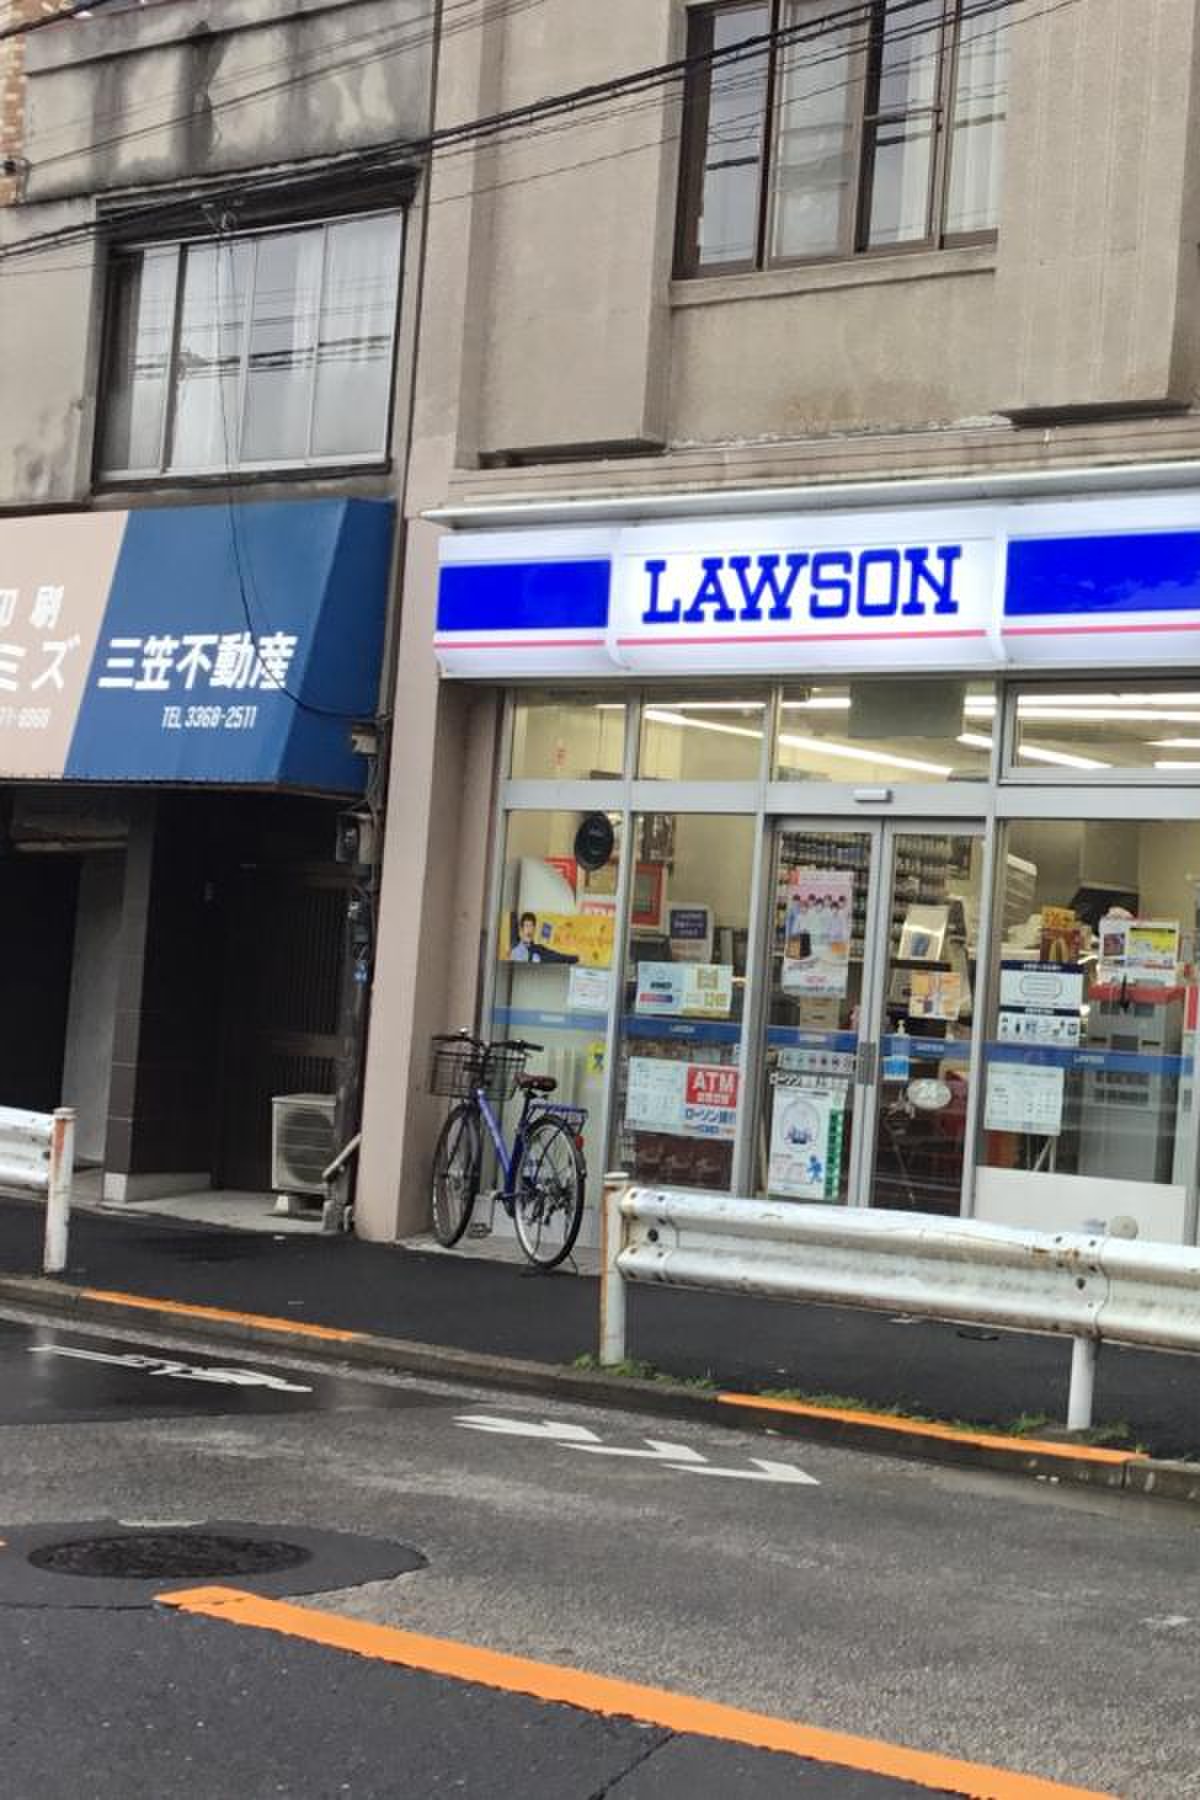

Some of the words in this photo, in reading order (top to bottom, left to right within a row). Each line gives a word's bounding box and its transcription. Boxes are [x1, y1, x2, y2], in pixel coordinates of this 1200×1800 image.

[642, 545, 963, 624] LAWSON
[97, 631, 298, 692] 三笠不動産
[692, 1071, 736, 1093] ATM
